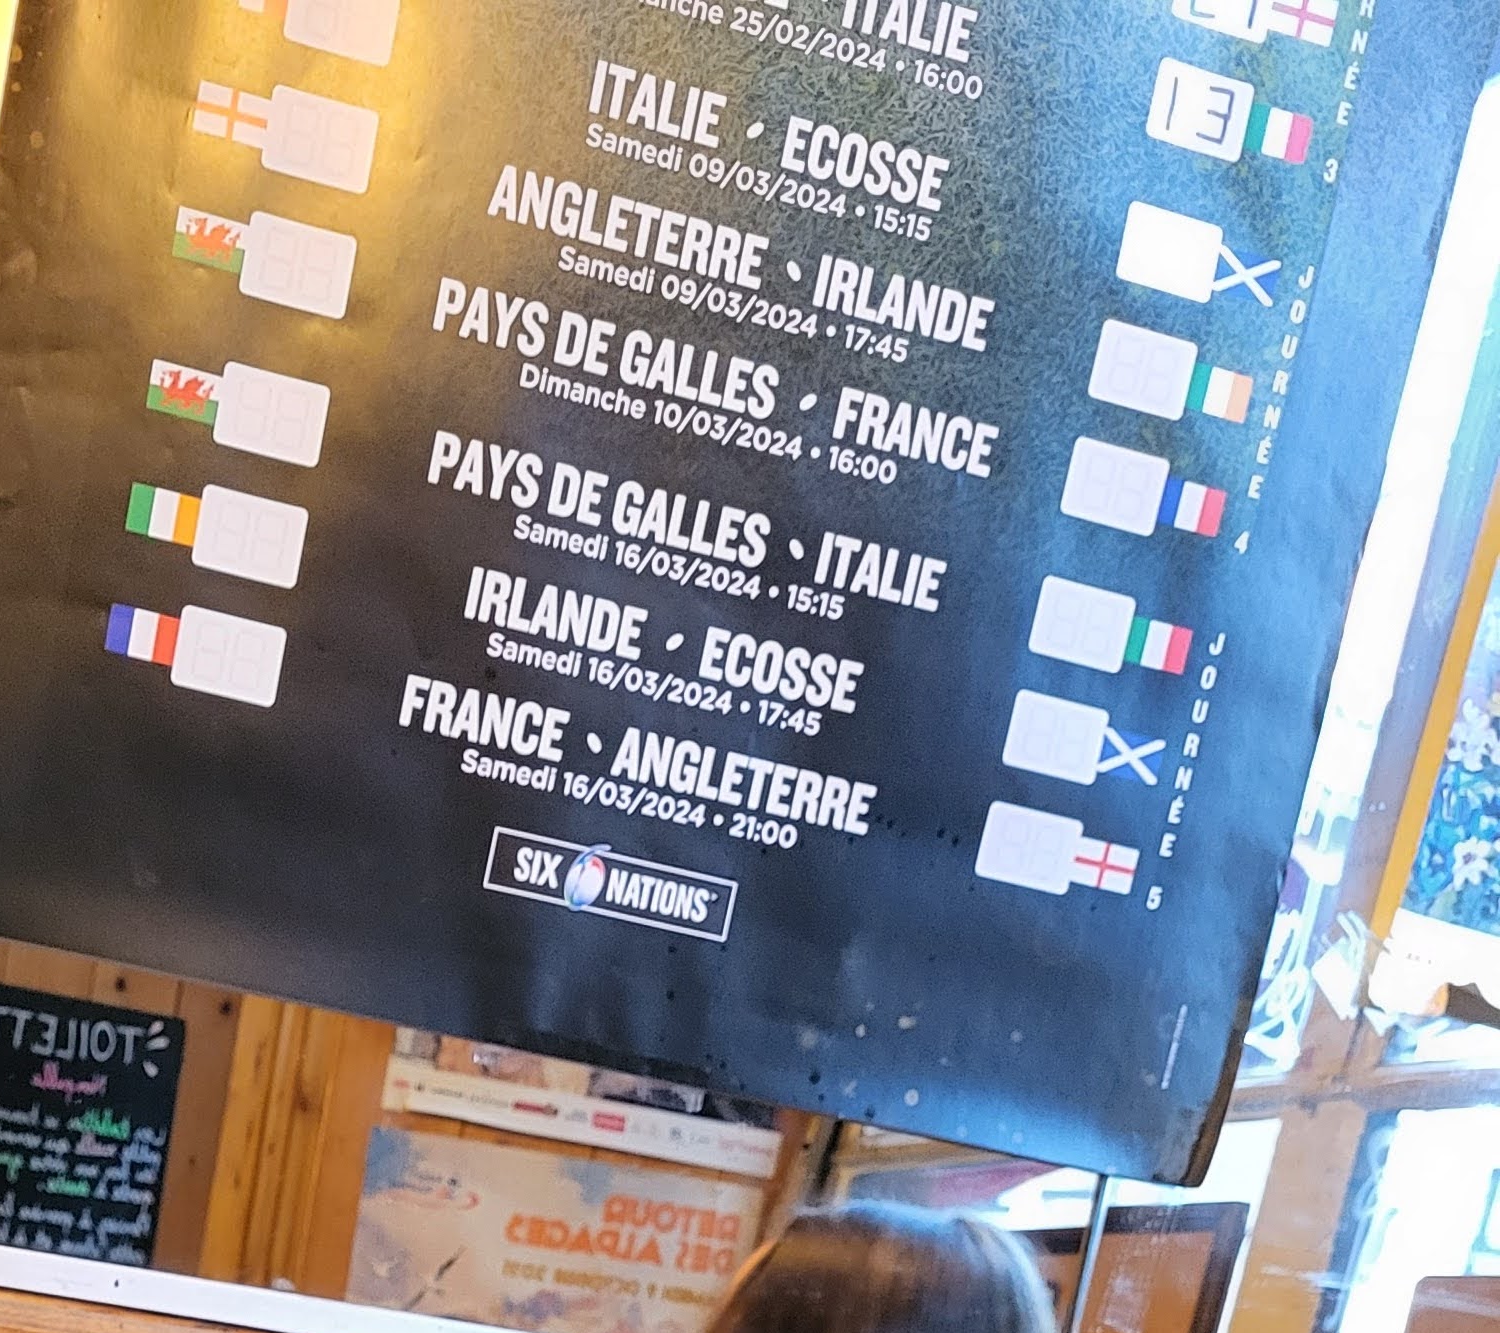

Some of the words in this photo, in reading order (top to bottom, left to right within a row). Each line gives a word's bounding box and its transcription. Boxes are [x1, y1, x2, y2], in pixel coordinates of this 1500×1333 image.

[729, 6, 887, 73] 25/02/2024
[914, 58, 983, 100] 16:00
[841, 0, 979, 63] ITALIE
[585, 122, 684, 172] Samedi
[688, 152, 847, 218] 09/03/2024
[874, 204, 933, 242] 15:15
[588, 59, 728, 149] ITALIE
[780, 115, 951, 212] ECOSSE
[1323, 158, 1339, 184] 3
[487, 164, 770, 290] ANGLETERRE
[812, 254, 996, 352] IRLANDE
[558, 245, 656, 294] Samedi
[660, 274, 818, 339] 09/03/2024
[845, 324, 910, 363] 17:45
[432, 277, 550, 357] PAYS
[553, 310, 617, 377] DE
[619, 329, 780, 420] GALLES
[832, 386, 1000, 478] FRANCE
[519, 362, 647, 420] Dimanche
[654, 399, 803, 461] 10/03/2024
[829, 445, 898, 484] 16:00
[427, 430, 544, 509] PAYS
[547, 462, 609, 527] DE
[611, 480, 771, 568] GALLES
[814, 531, 948, 612] ITALIE
[513, 514, 610, 561] Samedi
[615, 540, 761, 600] 16/03/2024
[787, 584, 846, 620] 15:15
[1234, 532, 1250, 555] 4
[464, 566, 649, 661] IRLANDE
[698, 626, 865, 714] ECOSSE
[486, 632, 583, 678] Samedi
[588, 656, 732, 715] 16/03/2024
[758, 699, 822, 736] 17:45
[398, 674, 571, 763] FRANCE
[610, 727, 878, 836] ANGLETERRE
[460, 748, 558, 792] Samedi
[563, 771, 706, 828] 16/03/2024
[729, 812, 798, 849] 21:00
[513, 846, 564, 889] SIX
[605, 868, 710, 923] NATIONS
[1145, 886, 1164, 911] 5
